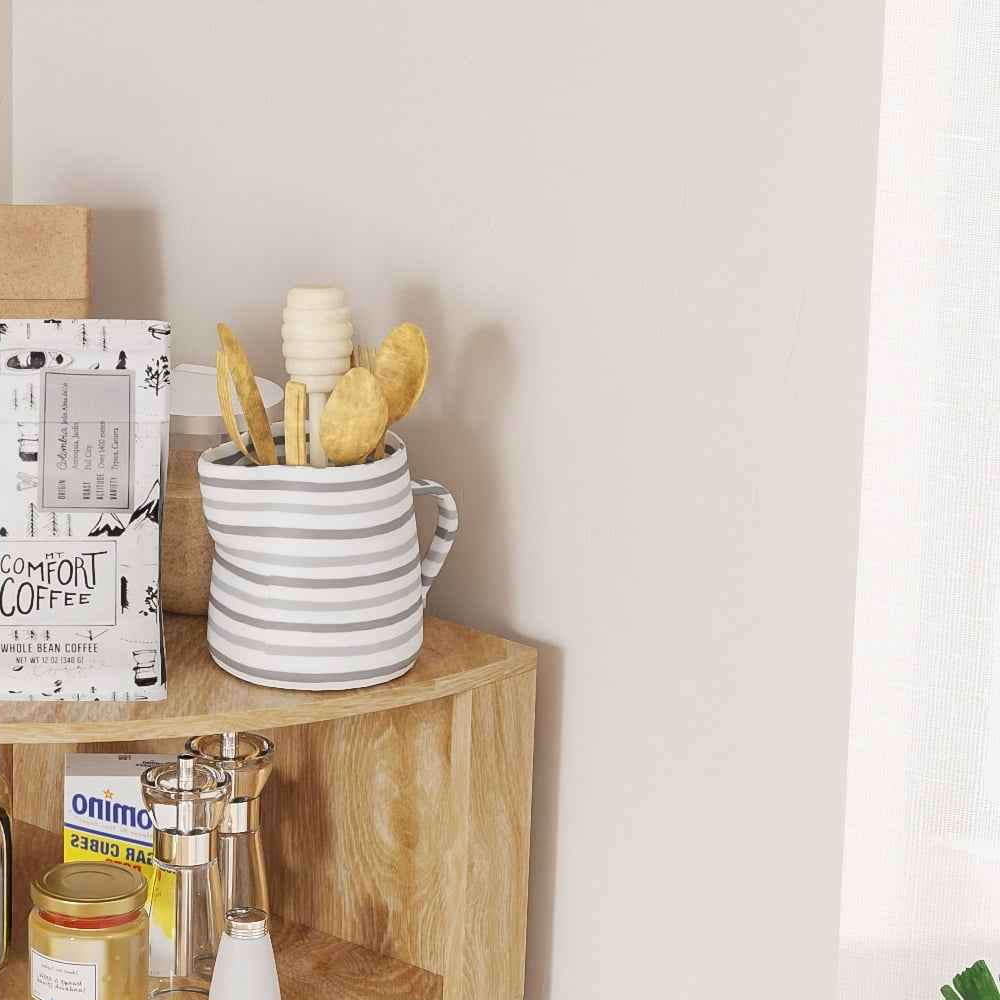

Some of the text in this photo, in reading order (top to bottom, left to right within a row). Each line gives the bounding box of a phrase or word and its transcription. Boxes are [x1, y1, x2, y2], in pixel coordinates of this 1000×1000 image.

[56, 427, 68, 471] Colombia
[57, 479, 66, 500] ORIGIN
[83, 482, 91, 500] ROAST
[96, 474, 104, 500] ALTITUDE
[110, 477, 118, 500] VARIETY
[46, 552, 64, 560] MT
[0, 551, 108, 589] COMFORT
[0, 577, 92, 617] COFFEE
[1, 643, 98, 653] WHOLE BEAN COFFEE
[16, 656, 28, 664] NET
[30, 656, 40, 664] WT
[42, 656, 49, 664] 12
[51, 656, 59, 664] OZ
[60, 656, 76, 665] (340
